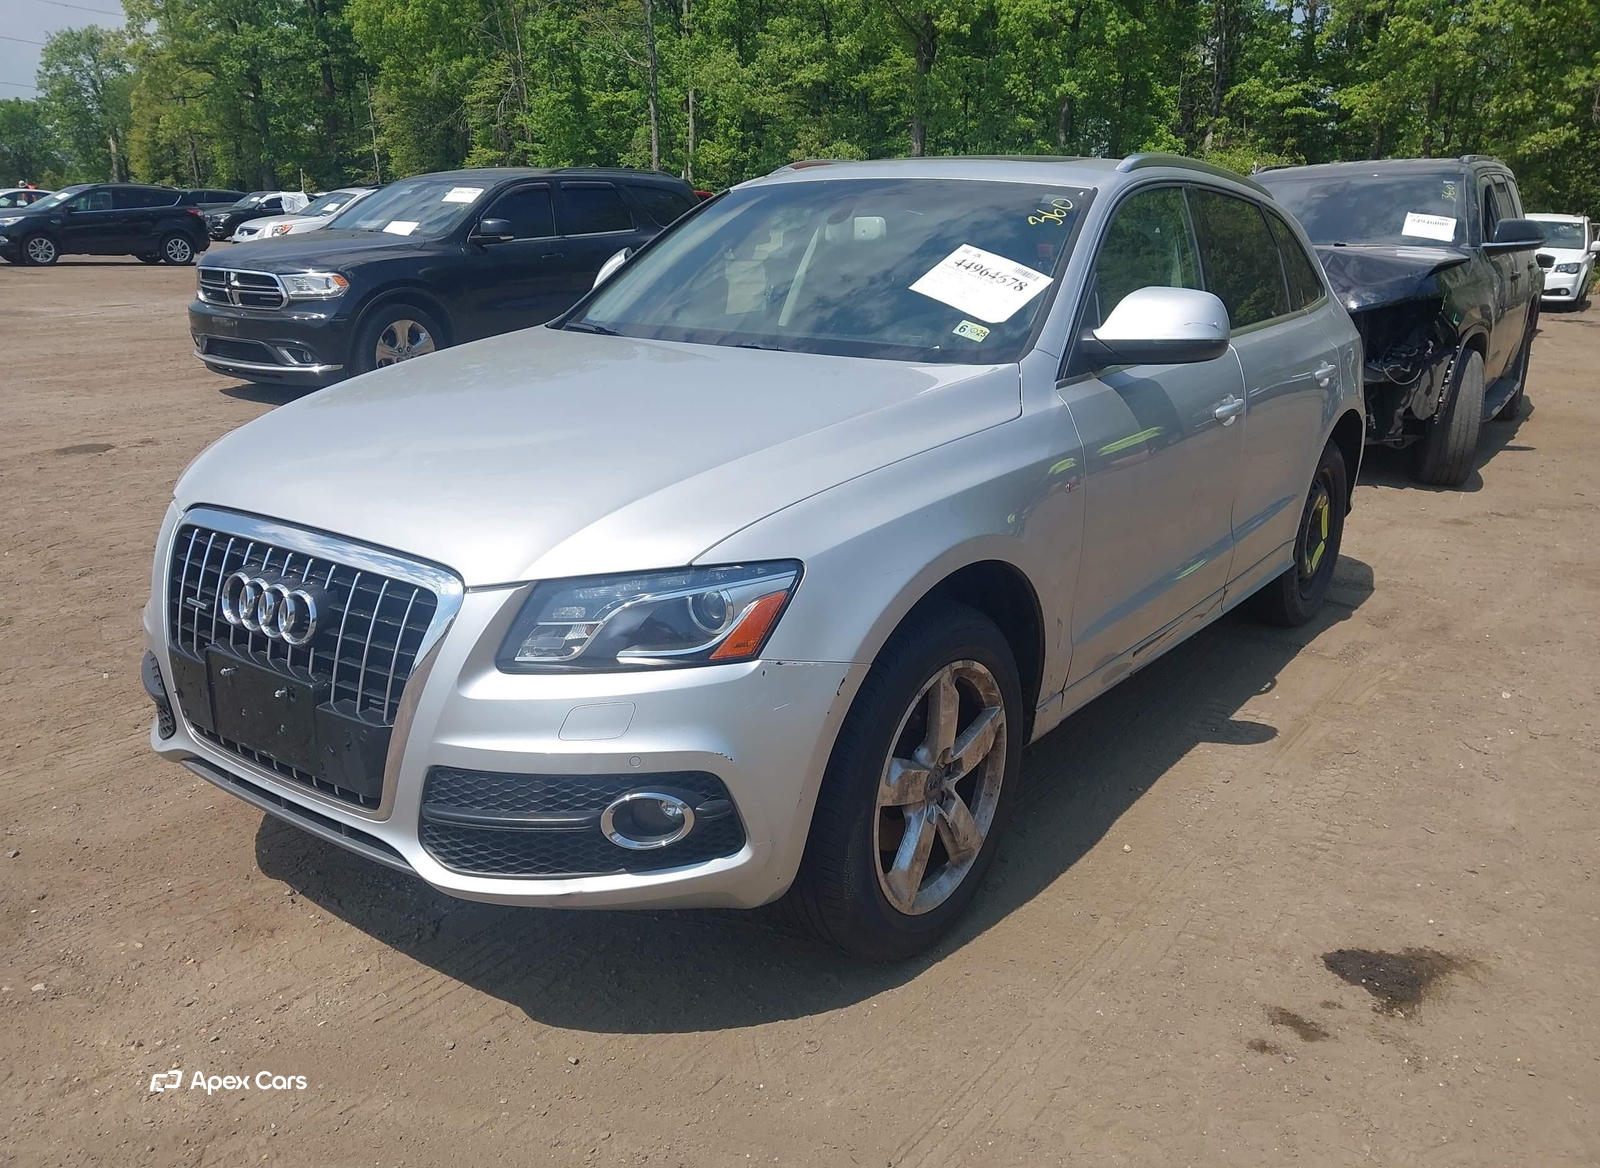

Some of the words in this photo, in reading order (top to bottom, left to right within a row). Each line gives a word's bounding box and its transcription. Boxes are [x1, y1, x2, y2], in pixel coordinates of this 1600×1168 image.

[1027, 198, 1073, 225] 360
[954, 258, 1028, 291] 44964578
[958, 324, 968, 333] 6
[976, 329, 988, 337] 25
